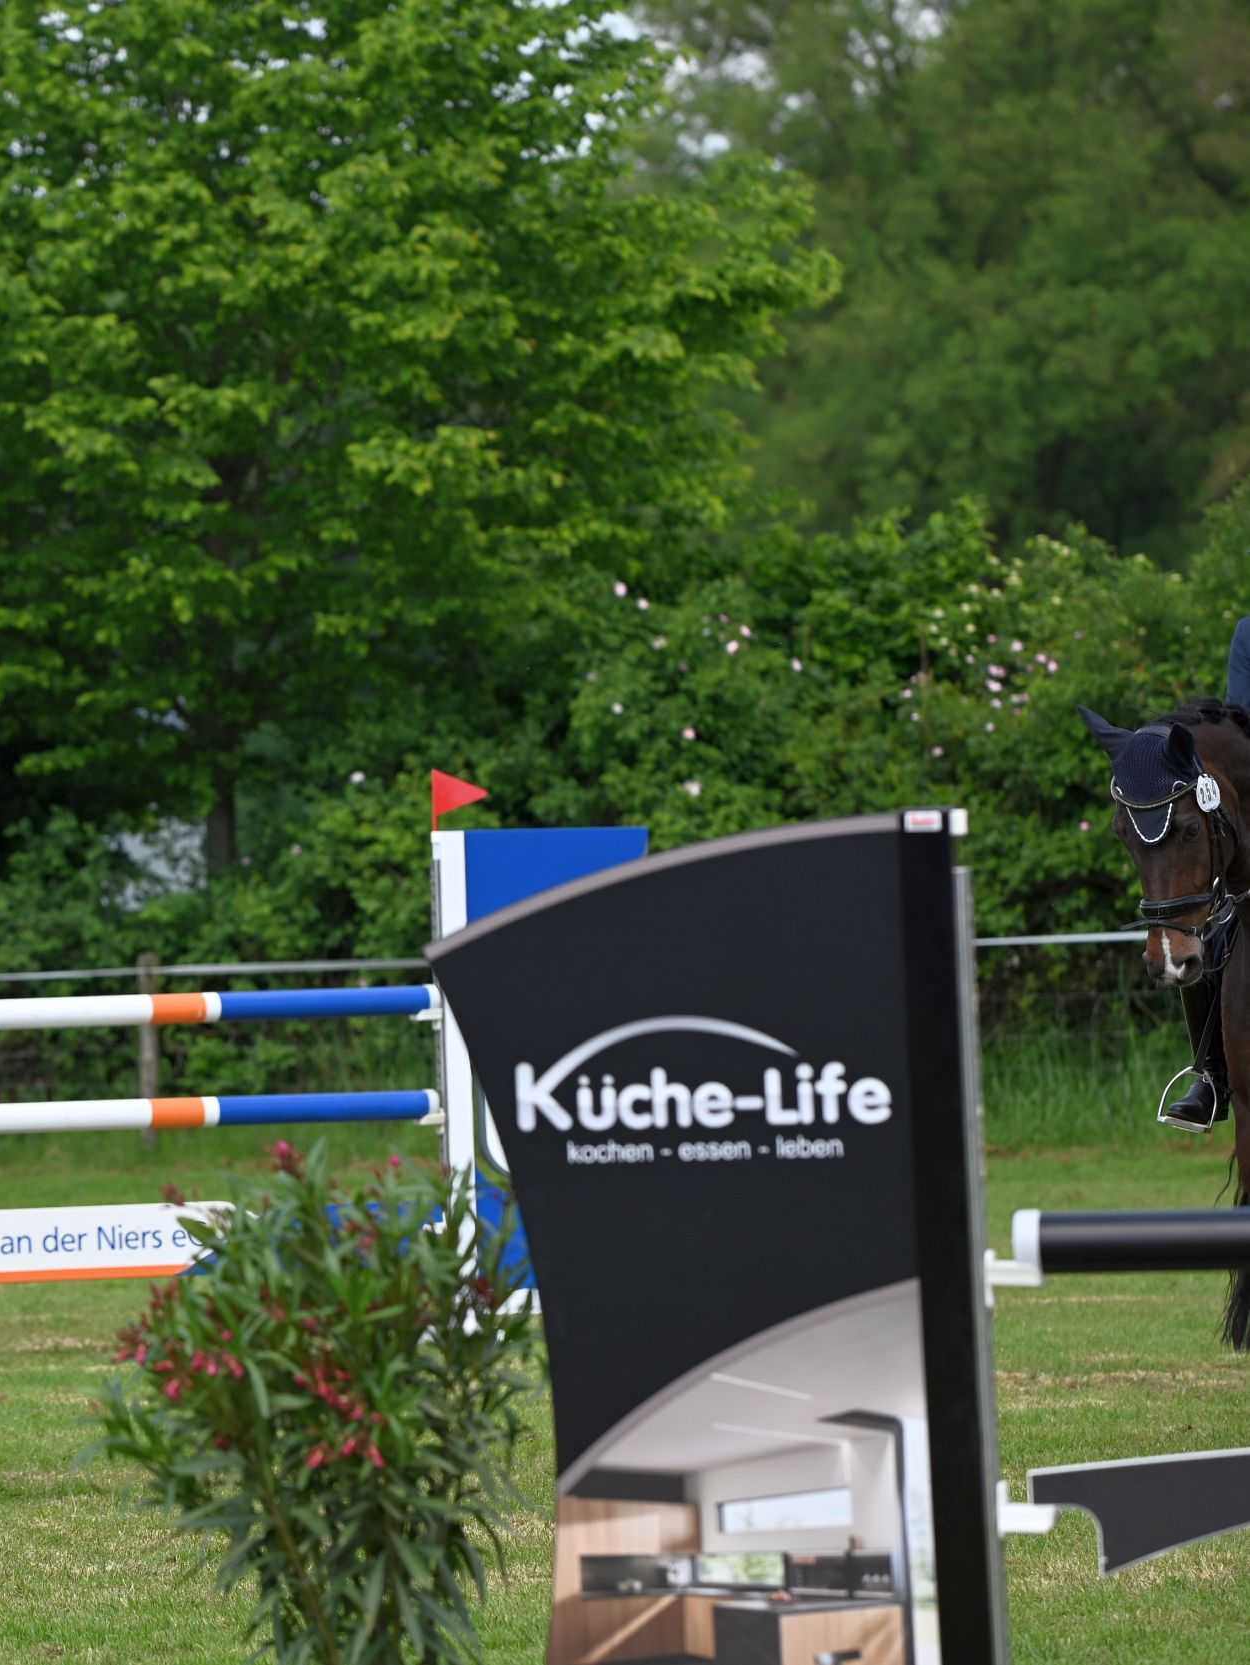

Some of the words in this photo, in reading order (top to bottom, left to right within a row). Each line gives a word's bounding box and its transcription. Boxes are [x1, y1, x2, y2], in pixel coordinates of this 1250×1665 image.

[515, 1062, 892, 1133] Küche-Life
[567, 1140, 654, 1164] kochen
[678, 1141, 751, 1161] essen
[776, 1135, 844, 1159] leben
[0, 1233, 32, 1255] an
[42, 1227, 87, 1253] der
[97, 1226, 163, 1251] Niers
